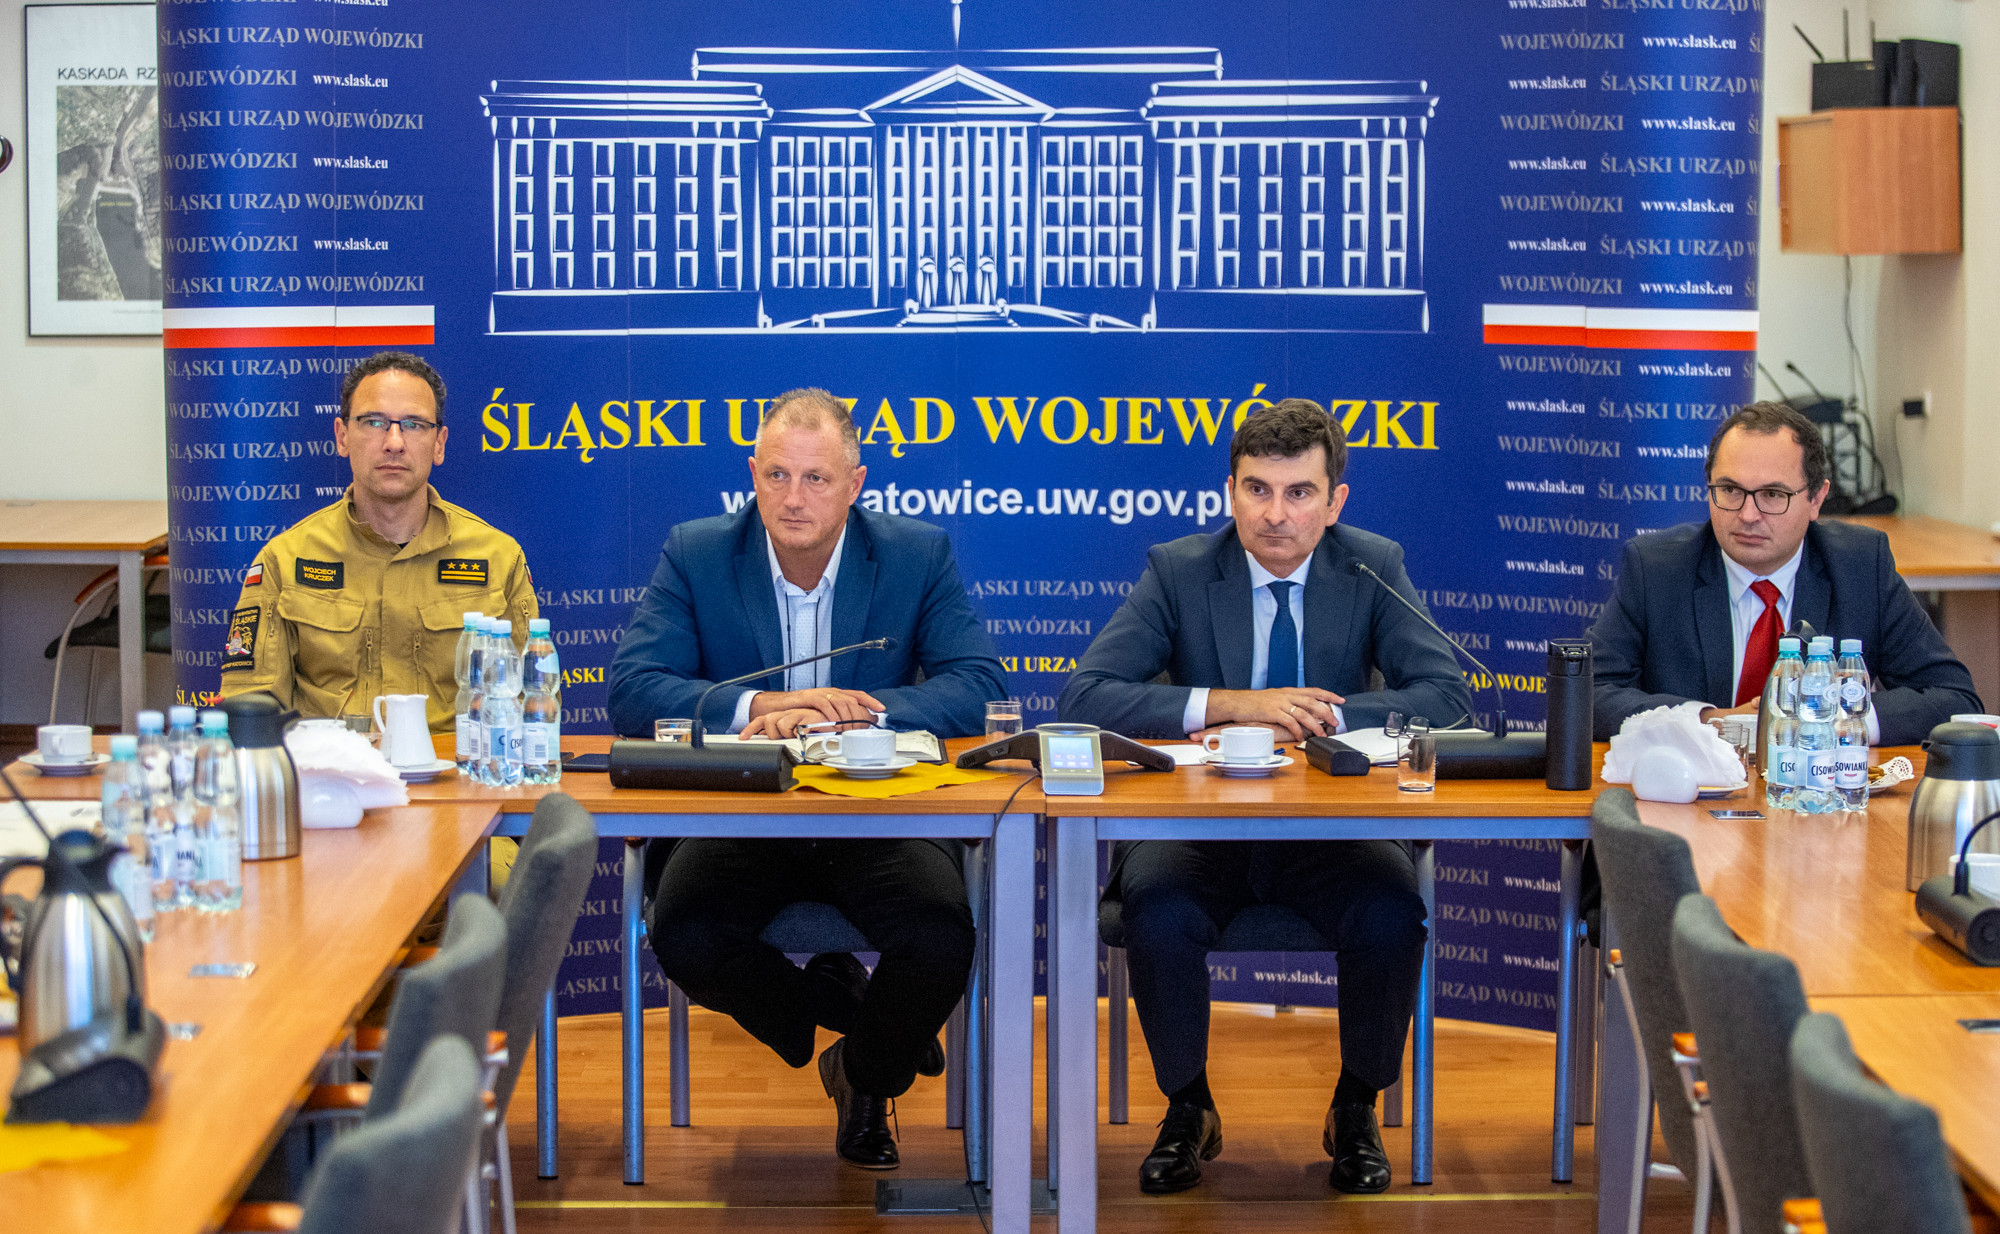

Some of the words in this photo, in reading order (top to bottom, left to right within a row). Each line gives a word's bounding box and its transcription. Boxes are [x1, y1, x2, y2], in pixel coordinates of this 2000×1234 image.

[161, 26, 220, 48] ŚLĄSKI
[227, 27, 299, 47] URZĄD
[304, 27, 424, 49] WOJEWÓDZKI
[1500, 29, 1624, 50] WOJEWÓDZKI
[1643, 35, 1737, 50] www.slask.eu
[57, 67, 128, 80] KASKADA
[162, 65, 298, 88] WOJEWÓDZKI
[313, 72, 389, 88] www.slask.eu
[1508, 76, 1586, 89] www.slask.eu
[1601, 71, 1673, 95] ŚLĄSKI
[1680, 75, 1747, 97] URZĄD
[163, 110, 221, 132] ŚLĄSKI
[229, 110, 300, 130] URZĄD
[305, 109, 424, 130] WOJEWÓDZKI
[1500, 109, 1623, 131] WOJEWÓDZKI
[1641, 116, 1735, 131] www.slask.eu
[162, 150, 298, 171] WOJEWÓDZKI
[314, 155, 389, 170] www.slask.eu
[1508, 157, 1586, 171] www.slask.eu
[1600, 152, 1672, 177] ŚLĄSKI
[1679, 157, 1746, 179] URZĄD
[164, 193, 223, 215] ŚLĄSKI
[230, 193, 301, 214] URZĄD
[305, 192, 424, 212] WOJEWÓDZKI
[1500, 190, 1623, 213] WOJEWÓDZKI
[1640, 198, 1734, 213] www.slask.eu
[164, 232, 298, 254] WOJEWÓDZKI
[314, 237, 389, 252] www.slask.eu
[1508, 237, 1586, 252] www.slask.eu
[1600, 234, 1671, 259] ŚLĄSKI
[1678, 240, 1743, 261] URZĄD
[165, 273, 223, 296] ŚLĄSKI
[231, 275, 301, 296] URZĄD
[306, 273, 425, 293] WOJEWÓDZKI
[1500, 272, 1622, 295] WOJEWÓDZKI
[1640, 280, 1733, 296] www.slask.eu
[168, 357, 224, 380] ŚLĄSKI
[231, 359, 301, 379] URZĄD
[1499, 353, 1621, 377] WOJEWÓDZKI
[1638, 362, 1731, 378] www.slask.eu
[168, 398, 300, 419] WOJEWÓDZKI
[1507, 399, 1585, 415] www.slask.eu
[1599, 397, 1668, 422] ŚLĄSKI
[482, 387, 705, 463] ŚLĄSKI
[724, 397, 956, 459] UĄD
[973, 383, 1440, 451] WOJEWZKI
[169, 439, 225, 463] ŚLĄSKI
[233, 441, 302, 462] URZĄD
[1499, 433, 1621, 458] WOJEWÓDZKI
[1637, 444, 1709, 459] www.slask
[170, 481, 301, 502] WOJEWÓDZKI
[721, 479, 1234, 526] watowice.uw.gov.pl
[1506, 479, 1585, 495] www.slask.eu
[1598, 478, 1666, 504] ŚLĄSKI
[1674, 485, 1709, 502] URZ
[171, 521, 227, 546] ŚLĄSKI
[235, 524, 286, 542] URZ
[1498, 514, 1620, 540] WOJEWÓDZKI
[303, 565, 337, 575] WOJCIECH
[304, 573, 335, 581] KRUCZEK
[1506, 559, 1584, 576] www.slask.eu
[536, 586, 603, 609] ŚLĄSKI
[610, 586, 649, 604] URZ
[967, 580, 1018, 599] ĄSKI
[1025, 580, 1094, 599] URZĄD
[174, 603, 229, 629] ŚLĄSKI
[1433, 590, 1493, 613] URZĄD
[1497, 594, 1604, 620] WOJEWÓDZ
[987, 615, 1091, 636] EWÓDZKI
[1506, 639, 1548, 653] www.sl
[560, 667, 605, 688] ĄSKI
[1506, 718, 1547, 732] www.sl
[1811, 764, 1835, 777] CISOW
[1835, 760, 1868, 772] SOWIANK
[1504, 875, 1561, 893] www.slask
[1503, 952, 1559, 972] www.slas
[556, 976, 607, 998] ĄSKI
